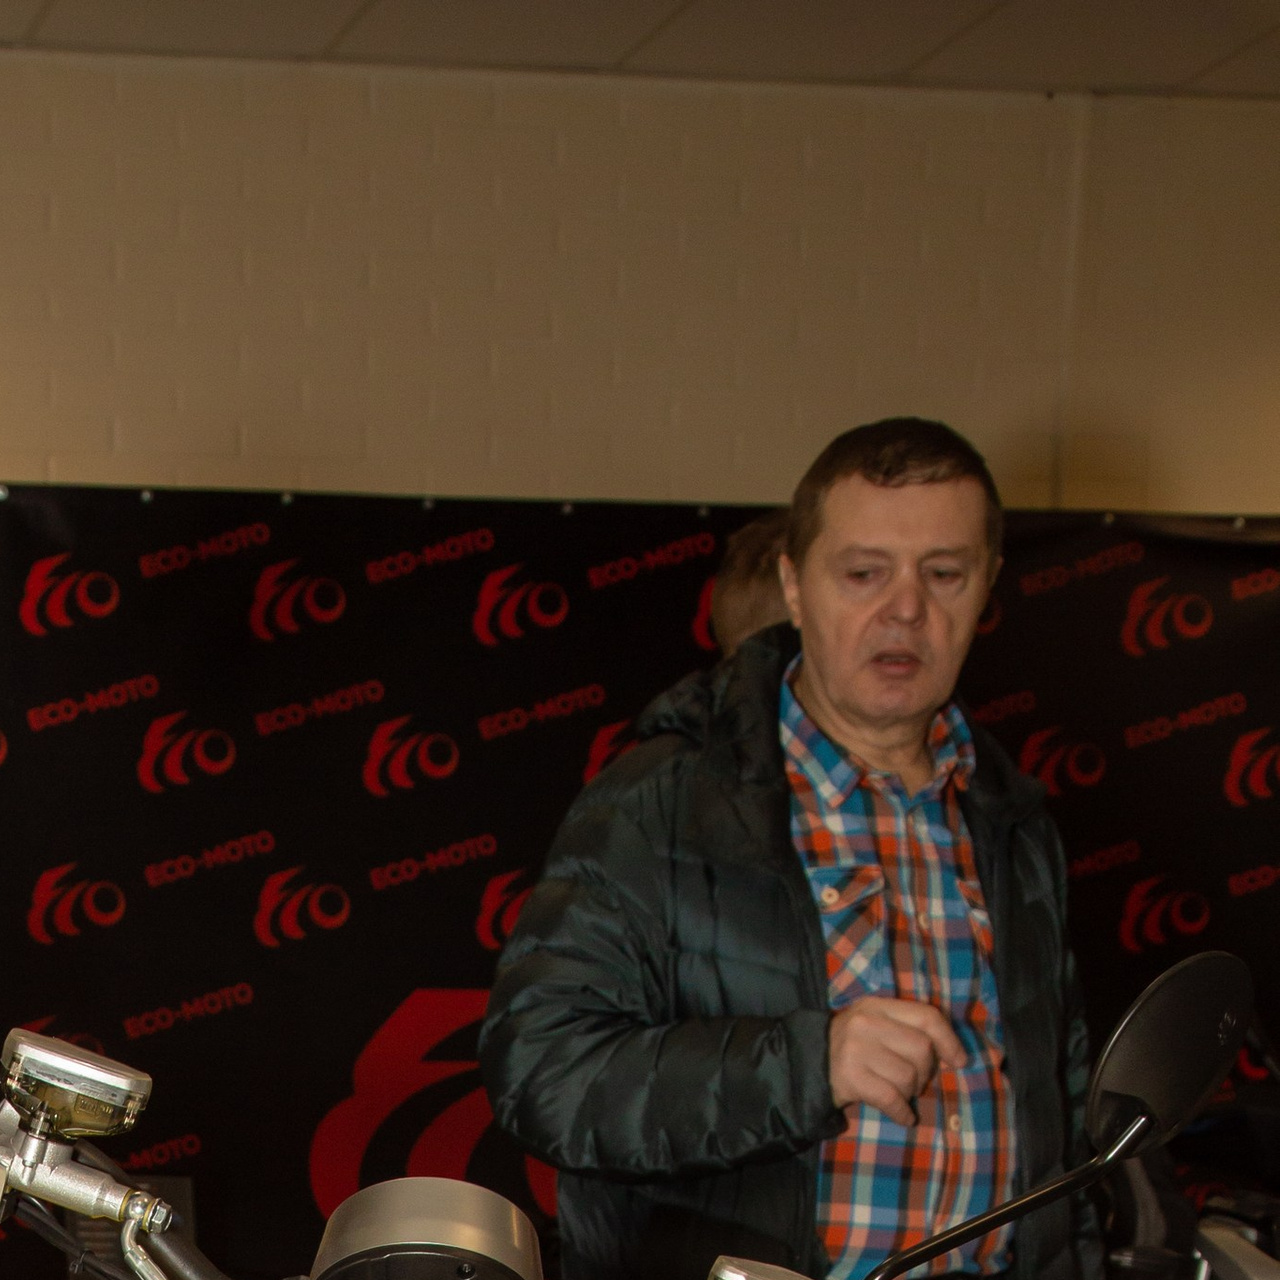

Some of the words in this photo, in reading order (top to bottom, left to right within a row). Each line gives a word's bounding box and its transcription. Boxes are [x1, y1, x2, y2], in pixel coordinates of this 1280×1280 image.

[138, 522, 271, 579] ECO-MOTO
[366, 527, 496, 584] ECO-MOTO
[587, 531, 716, 590] ECO-MOTO
[1019, 541, 1146, 596] ECO-MOTO
[26, 674, 161, 732] ECO-MOTO
[255, 679, 386, 737] ECO-MOTO
[477, 683, 608, 742] ECO-MOTO
[1124, 692, 1247, 749] ECO-MOTO
[145, 830, 277, 889] ECO-MOTO
[369, 833, 499, 891] ECO-MOTO
[122, 982, 255, 1040] ECO-MOTO
